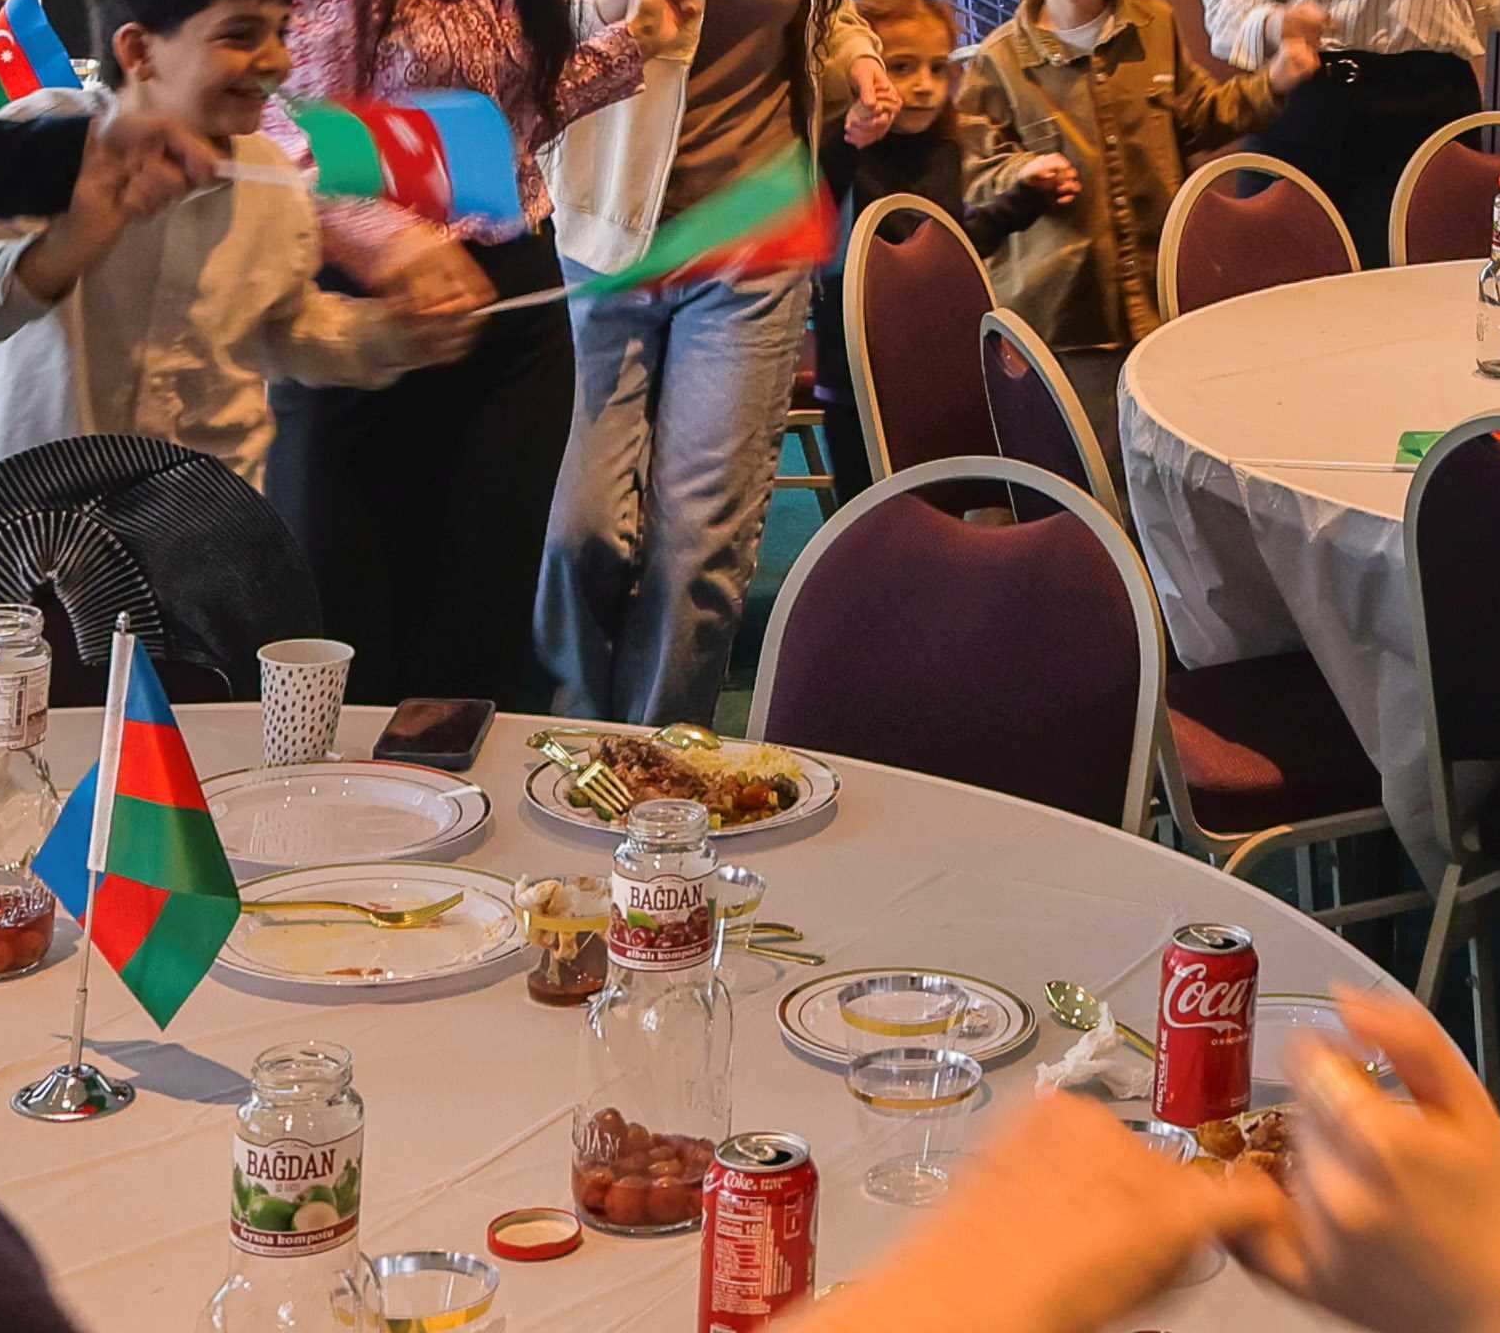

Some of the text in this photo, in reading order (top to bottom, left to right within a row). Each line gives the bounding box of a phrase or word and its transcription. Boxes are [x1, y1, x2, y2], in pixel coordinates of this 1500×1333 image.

[630, 883, 703, 911] BAĞDAN
[1156, 1028, 1168, 1113] RECYCLE ME
[246, 1148, 336, 1181] BAĞDAN
[723, 1170, 754, 1191] Coke
